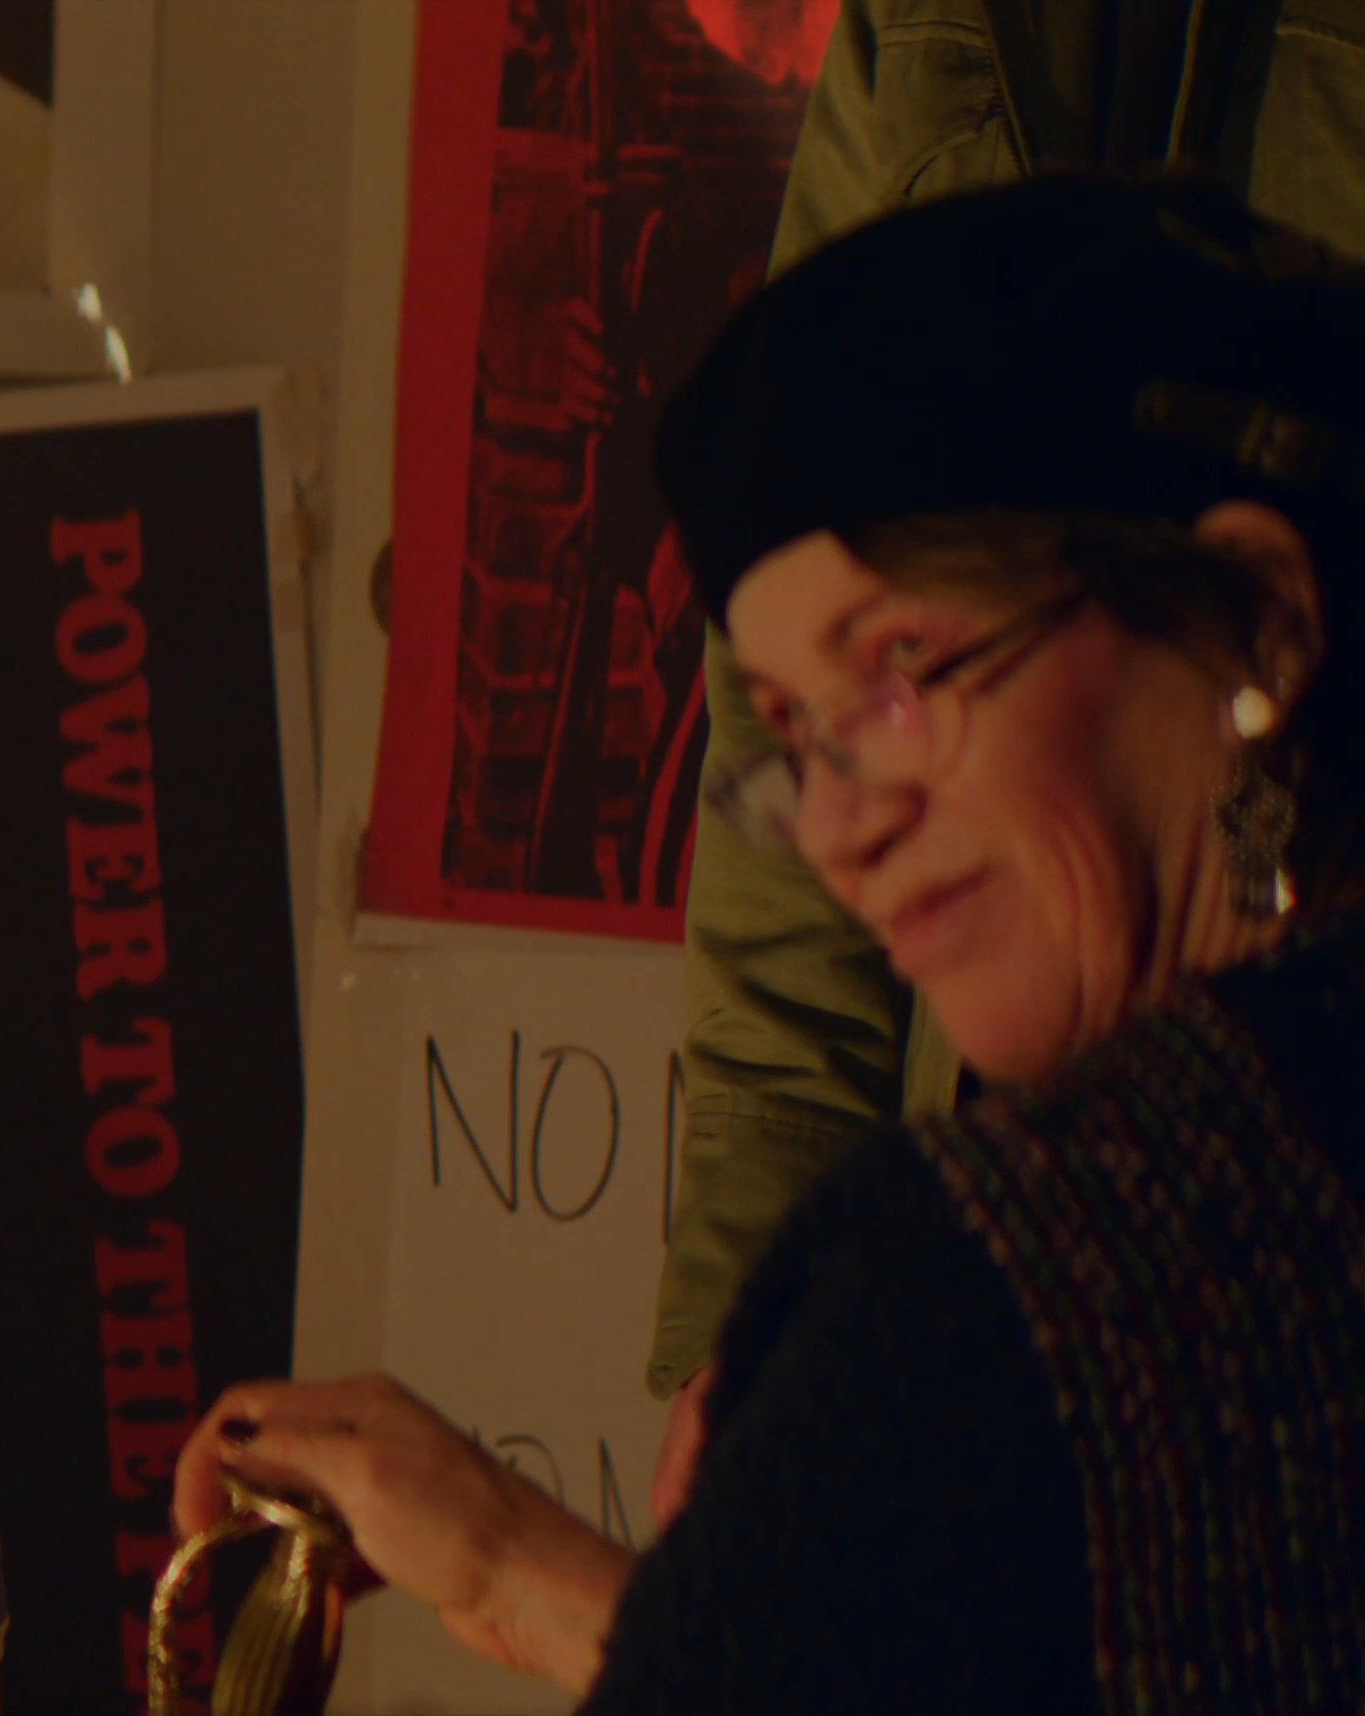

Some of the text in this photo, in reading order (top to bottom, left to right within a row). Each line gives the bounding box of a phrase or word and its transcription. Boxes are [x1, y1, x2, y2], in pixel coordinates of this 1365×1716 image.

[50, 507, 167, 1001] POWER
[78, 1030, 186, 1199] TO
[426, 1029, 620, 1222] NO
[94, 1221, 201, 1506] THE
